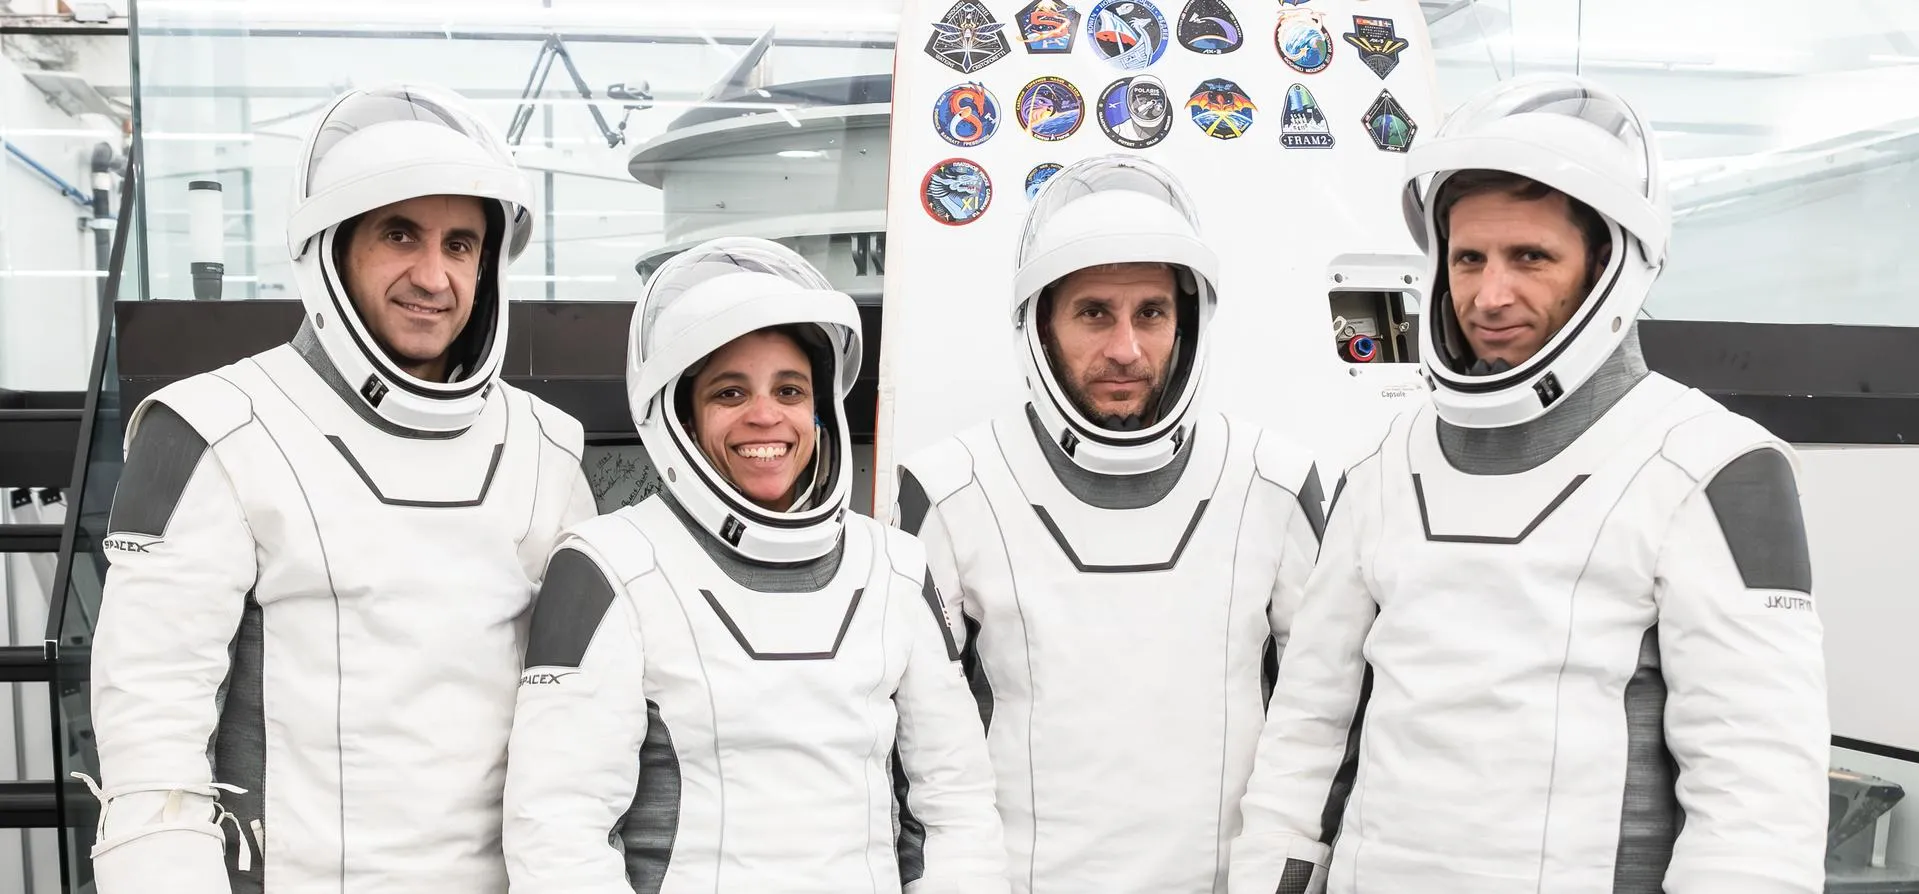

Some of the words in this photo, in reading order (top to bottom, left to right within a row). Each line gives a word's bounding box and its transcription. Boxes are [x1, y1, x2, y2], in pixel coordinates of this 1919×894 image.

[1287, 135, 1328, 145] FRAM2
[960, 196, 979, 212] XI
[1381, 391, 1406, 399] Capsule
[104, 539, 165, 553] SPACEX
